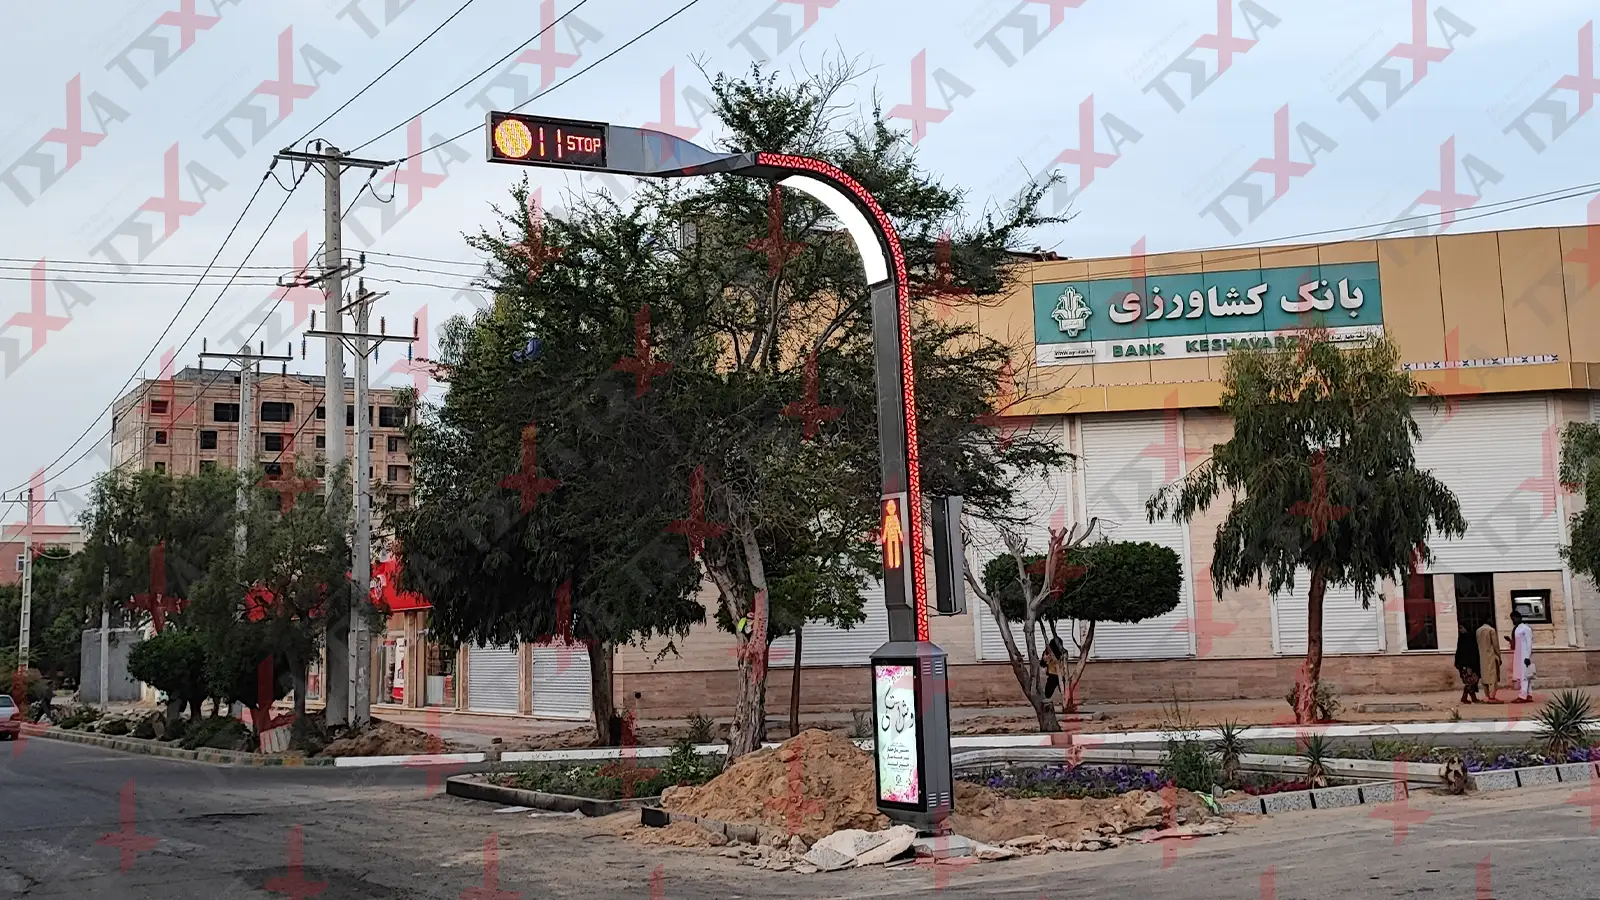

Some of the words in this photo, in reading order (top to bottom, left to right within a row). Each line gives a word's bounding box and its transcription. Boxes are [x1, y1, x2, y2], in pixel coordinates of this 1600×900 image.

[567, 135, 601, 153] STOP
[1109, 283, 1268, 323] کشاورزی
[1281, 277, 1364, 318] بانک
[1112, 342, 1166, 357] BANK
